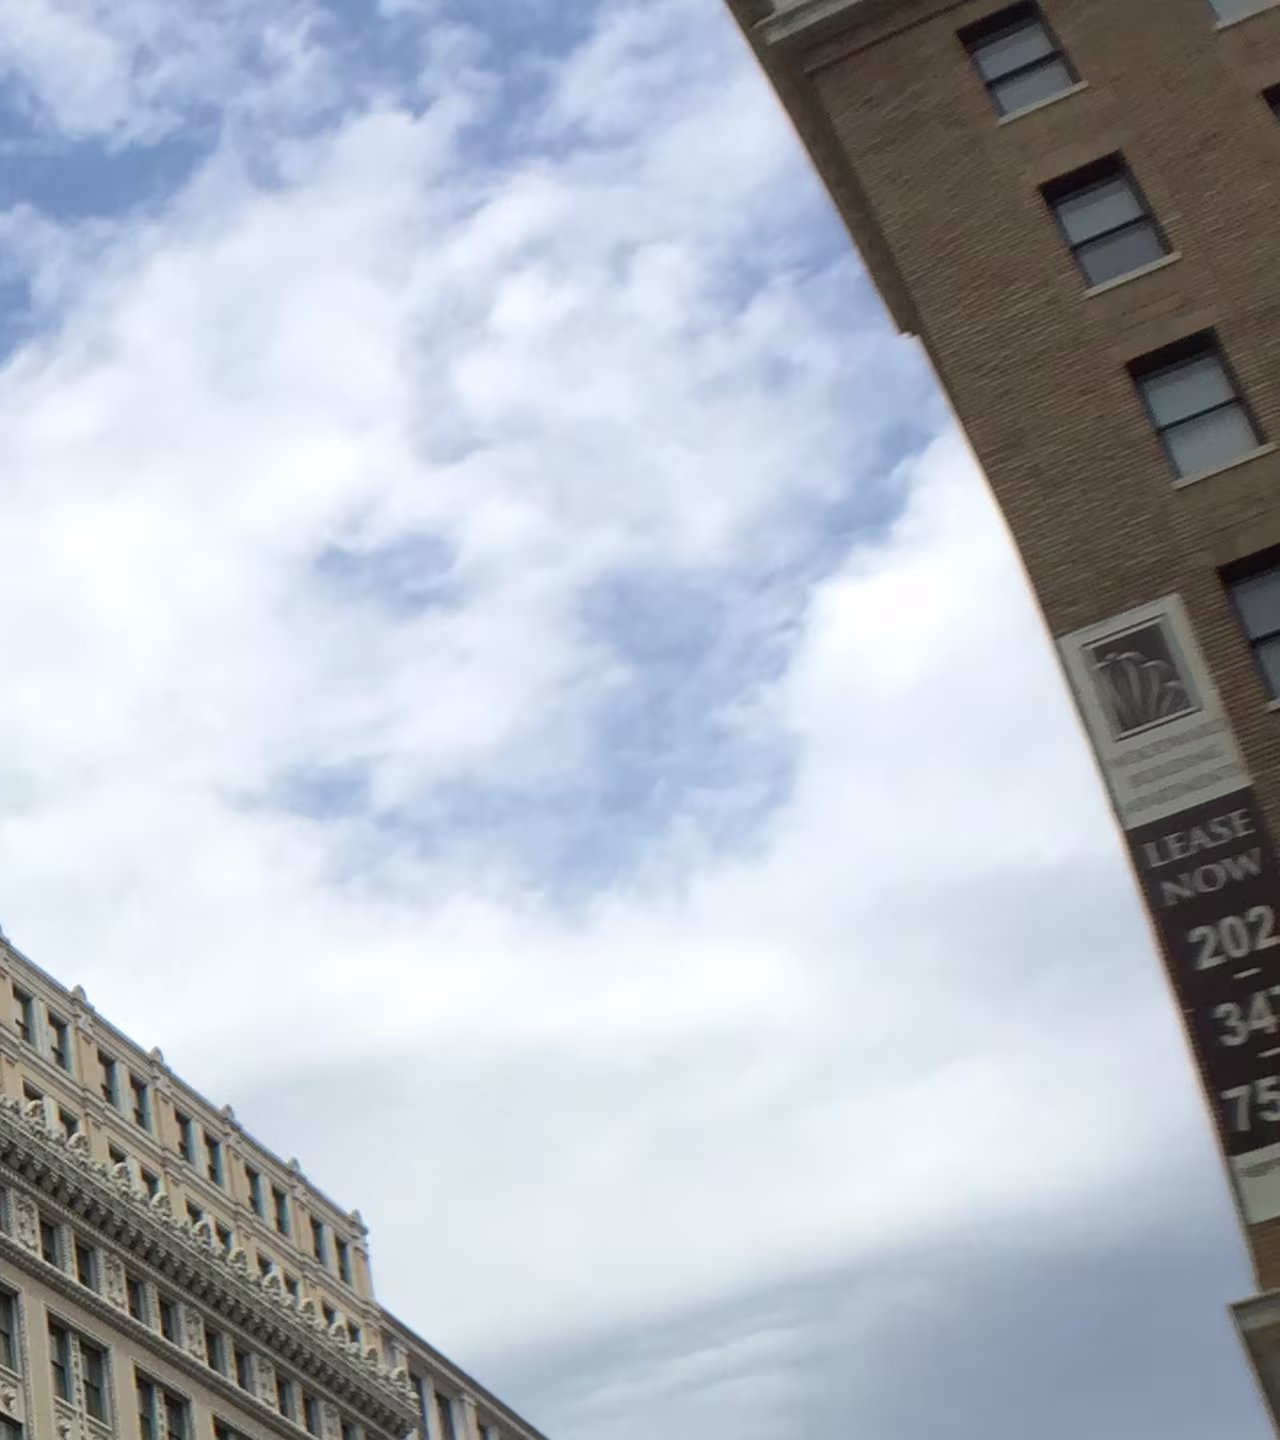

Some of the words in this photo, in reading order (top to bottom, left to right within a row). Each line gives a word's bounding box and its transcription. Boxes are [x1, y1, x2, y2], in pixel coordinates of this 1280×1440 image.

[1142, 808, 1256, 868] LEASE
[1160, 846, 1262, 907] NOW
[1187, 905, 1280, 970] 202
